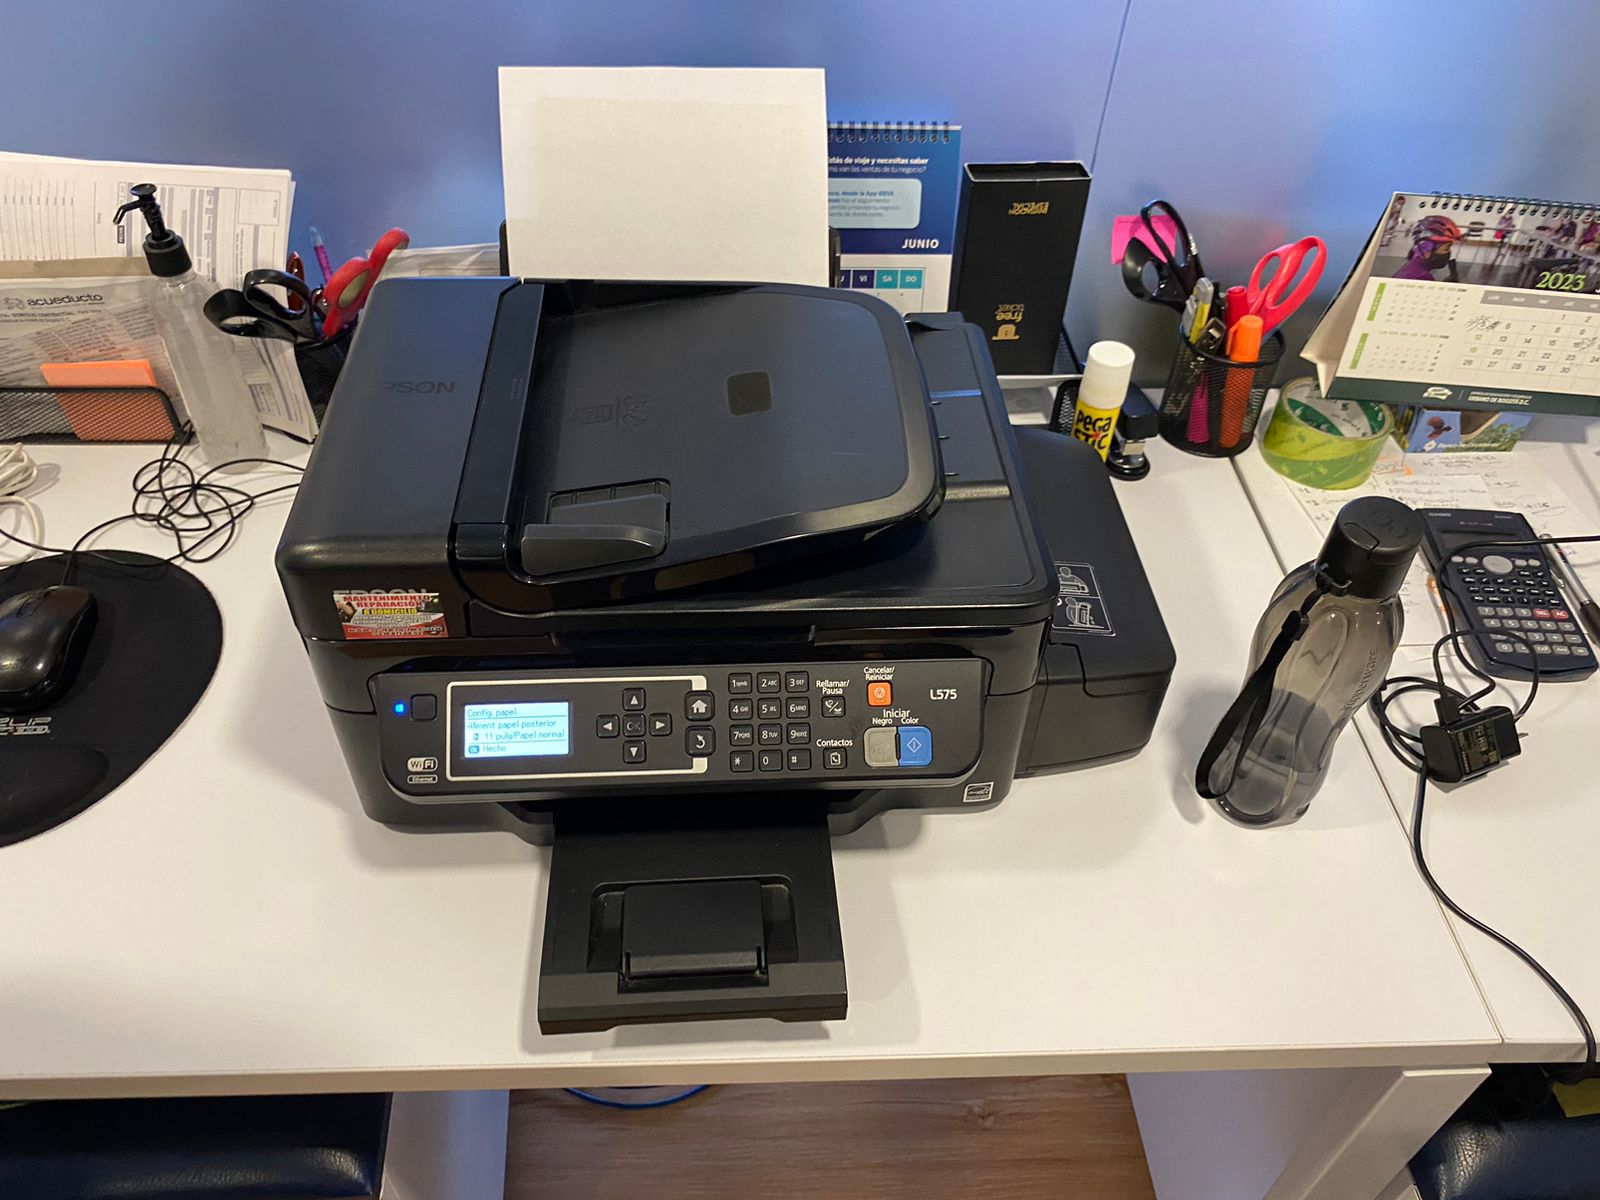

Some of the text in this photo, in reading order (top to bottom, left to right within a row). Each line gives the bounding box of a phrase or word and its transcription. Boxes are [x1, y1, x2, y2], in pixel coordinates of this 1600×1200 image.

[844, 156, 853, 164] de
[854, 156, 870, 166] viaje
[876, 156, 909, 164] necesitas
[902, 238, 939, 250] JUNIO
[1536, 272, 1587, 292] 2023
[27, 293, 104, 306] acueducto
[343, 594, 432, 602] MANTENIMIENTO
[864, 666, 895, 674] Cancelar/
[762, 678, 767, 688] 2
[790, 678, 796, 687] 3
[816, 680, 850, 688] Rellamar/
[930, 690, 958, 700] L575
[496, 708, 517, 717] papel
[732, 705, 739, 714] 4
[762, 704, 768, 713] 5
[883, 708, 910, 718] Iniciar
[498, 721, 520, 730] papel
[522, 720, 557, 728] posterior
[627, 721, 641, 732] OK
[872, 718, 893, 726] Negro
[762, 730, 768, 739] 8
[816, 738, 853, 748] Contactos
